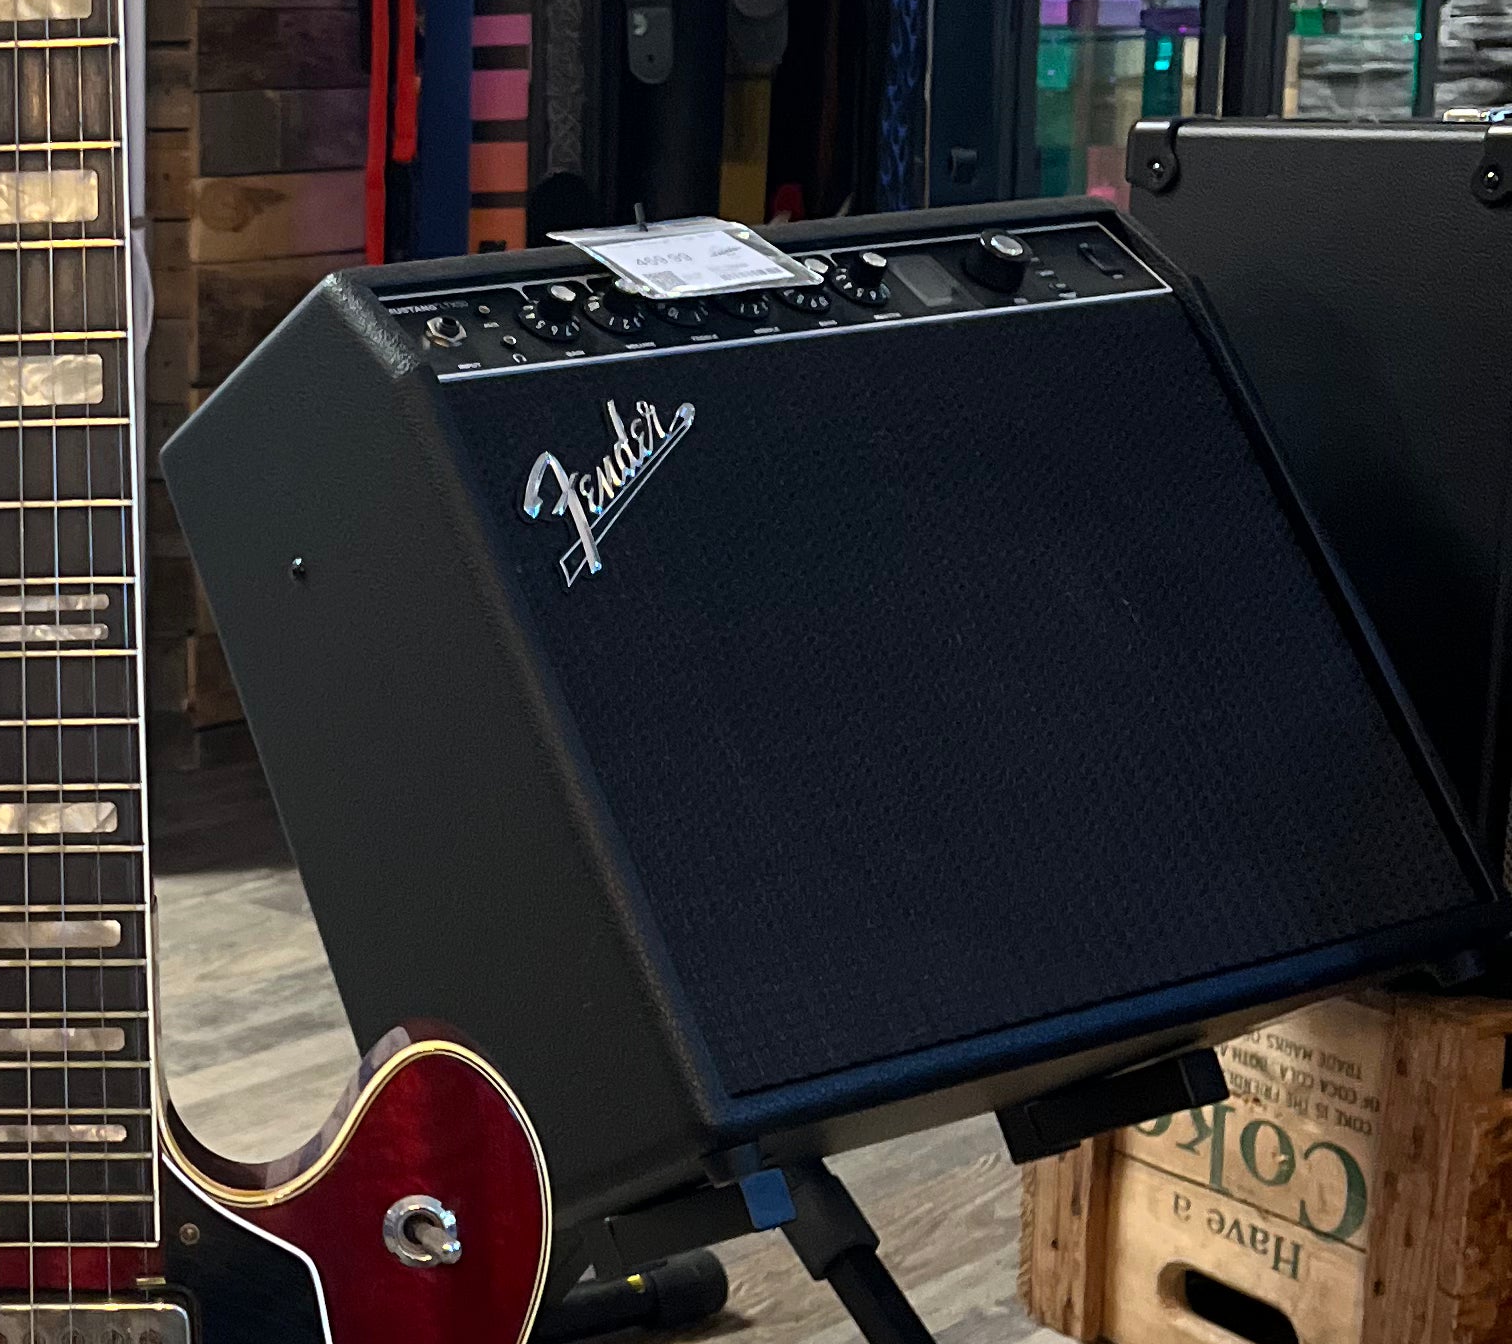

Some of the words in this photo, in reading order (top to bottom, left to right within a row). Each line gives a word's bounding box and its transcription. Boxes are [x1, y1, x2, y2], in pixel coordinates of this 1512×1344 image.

[523, 399, 696, 588] Fender
[1266, 1033, 1314, 1061] MARKS
[1318, 1051, 1362, 1080] TRADE
[1173, 1190, 1192, 1222] a
[1206, 1208, 1302, 1281] Have
